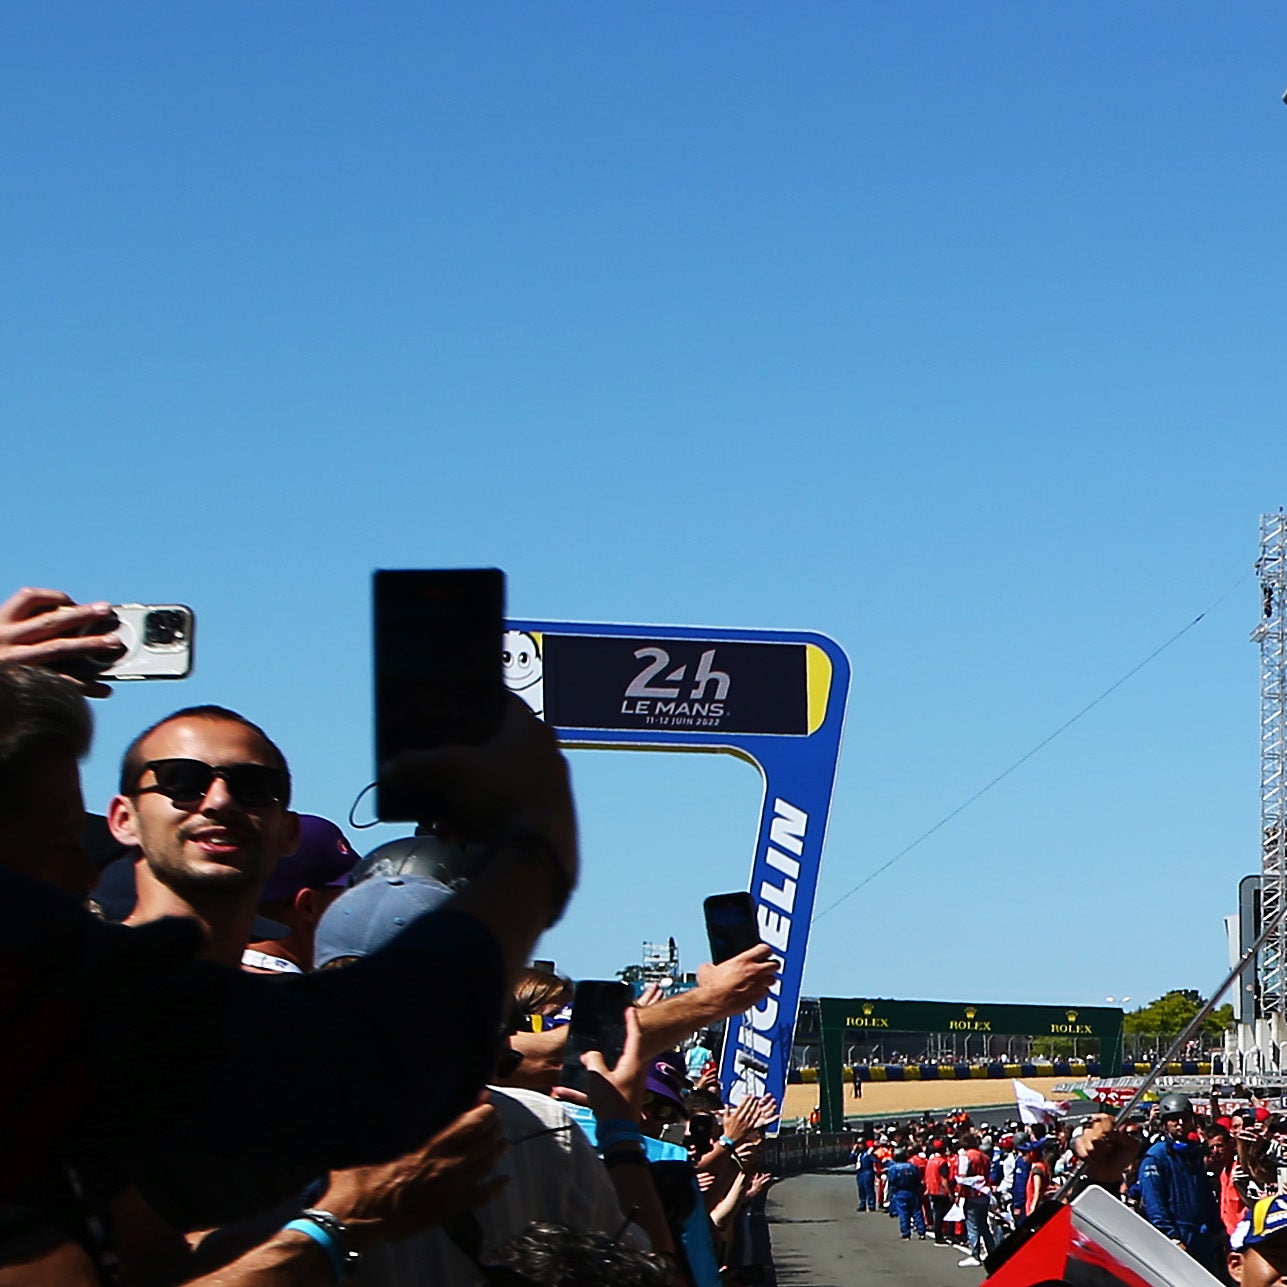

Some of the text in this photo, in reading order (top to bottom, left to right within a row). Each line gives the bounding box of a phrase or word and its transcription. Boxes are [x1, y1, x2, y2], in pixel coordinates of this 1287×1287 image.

[624, 647, 731, 700] 24h
[620, 700, 725, 717] LE MANS
[671, 716, 694, 726] JUIN
[695, 717, 721, 726] 2022
[729, 797, 809, 1108] MICELIN
[846, 1015, 890, 1028] ROLEX
[950, 1019, 993, 1032] ROLEX
[1051, 1023, 1093, 1035] ROLEX
